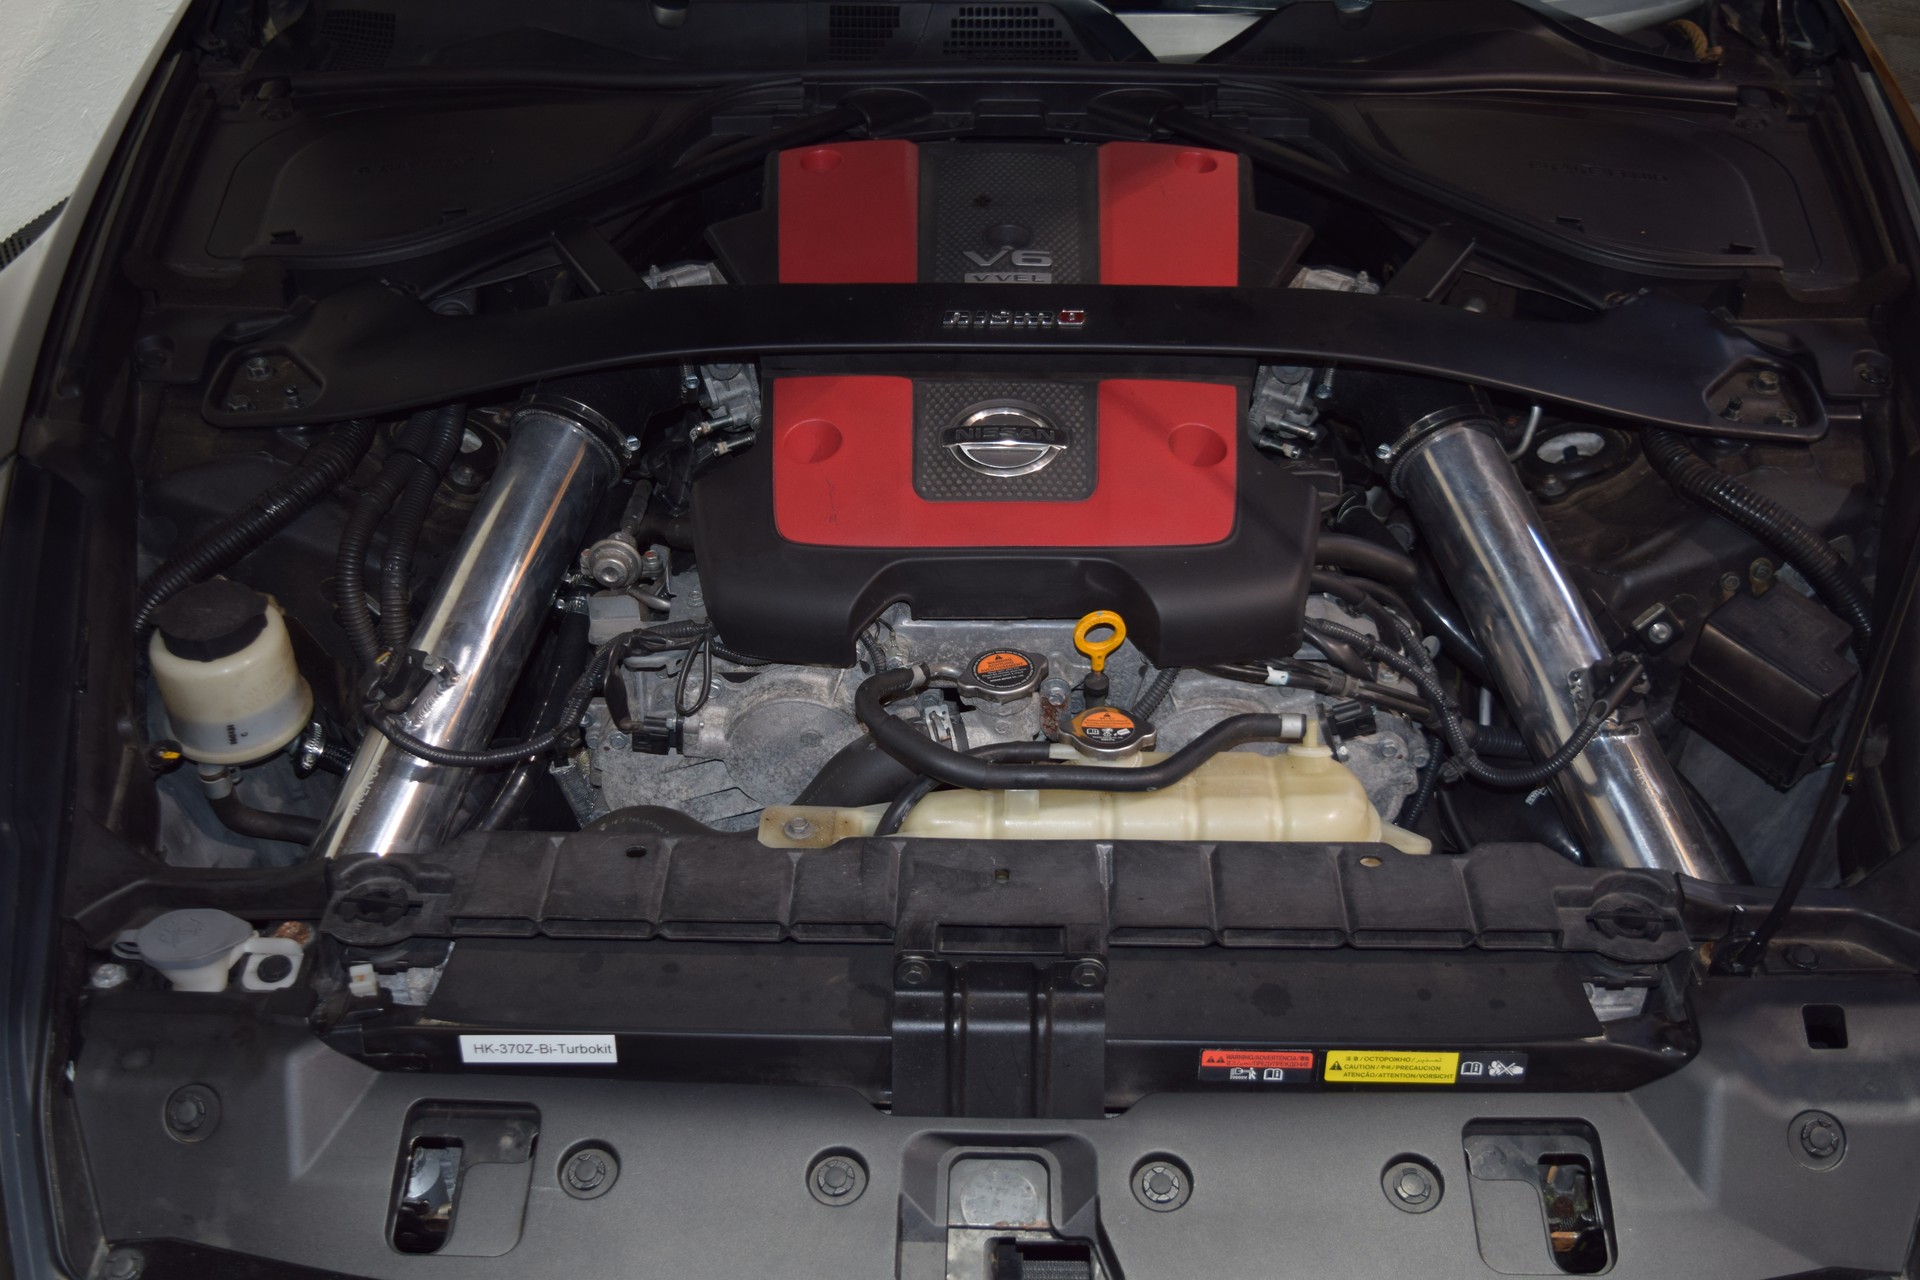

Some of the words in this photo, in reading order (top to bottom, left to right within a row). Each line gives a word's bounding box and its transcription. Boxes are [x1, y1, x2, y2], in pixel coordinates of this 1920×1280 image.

[962, 249, 1052, 267] V6
[972, 274, 1046, 283] VVEL
[955, 427, 1055, 441] NISSAN
[473, 1043, 612, 1055] HK-370Z-Bi-Turbokit
